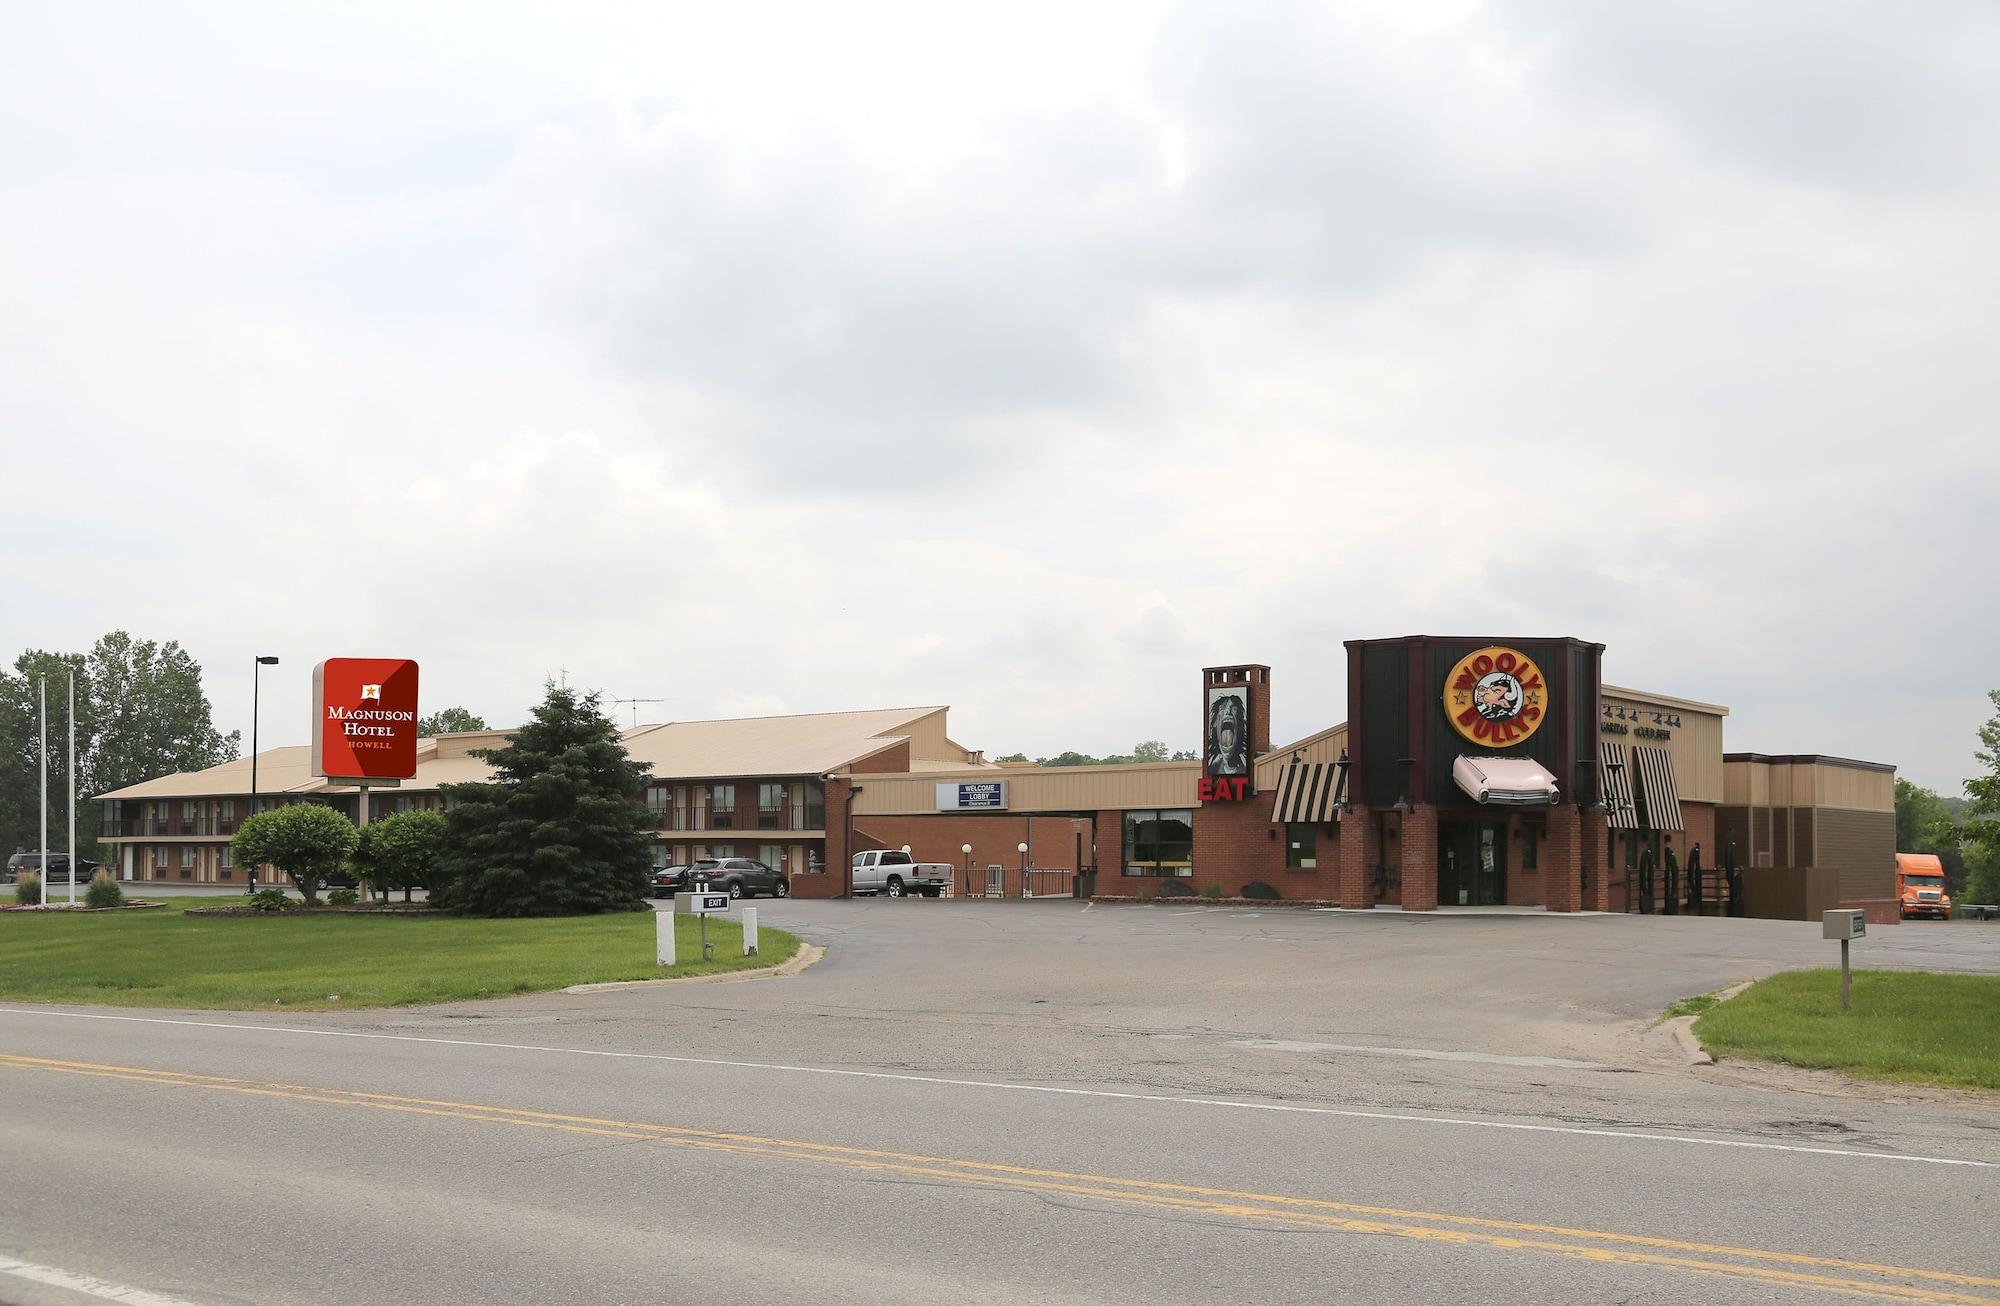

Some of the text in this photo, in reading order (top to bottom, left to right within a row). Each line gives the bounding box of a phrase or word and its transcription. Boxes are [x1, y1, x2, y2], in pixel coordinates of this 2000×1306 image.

[1453, 653, 1542, 690] WOOLY
[328, 706, 413, 721] MAGNUSON
[344, 723, 395, 737] HOTEL
[348, 741, 392, 749] HOWELL
[1198, 777, 1248, 800] EAT
